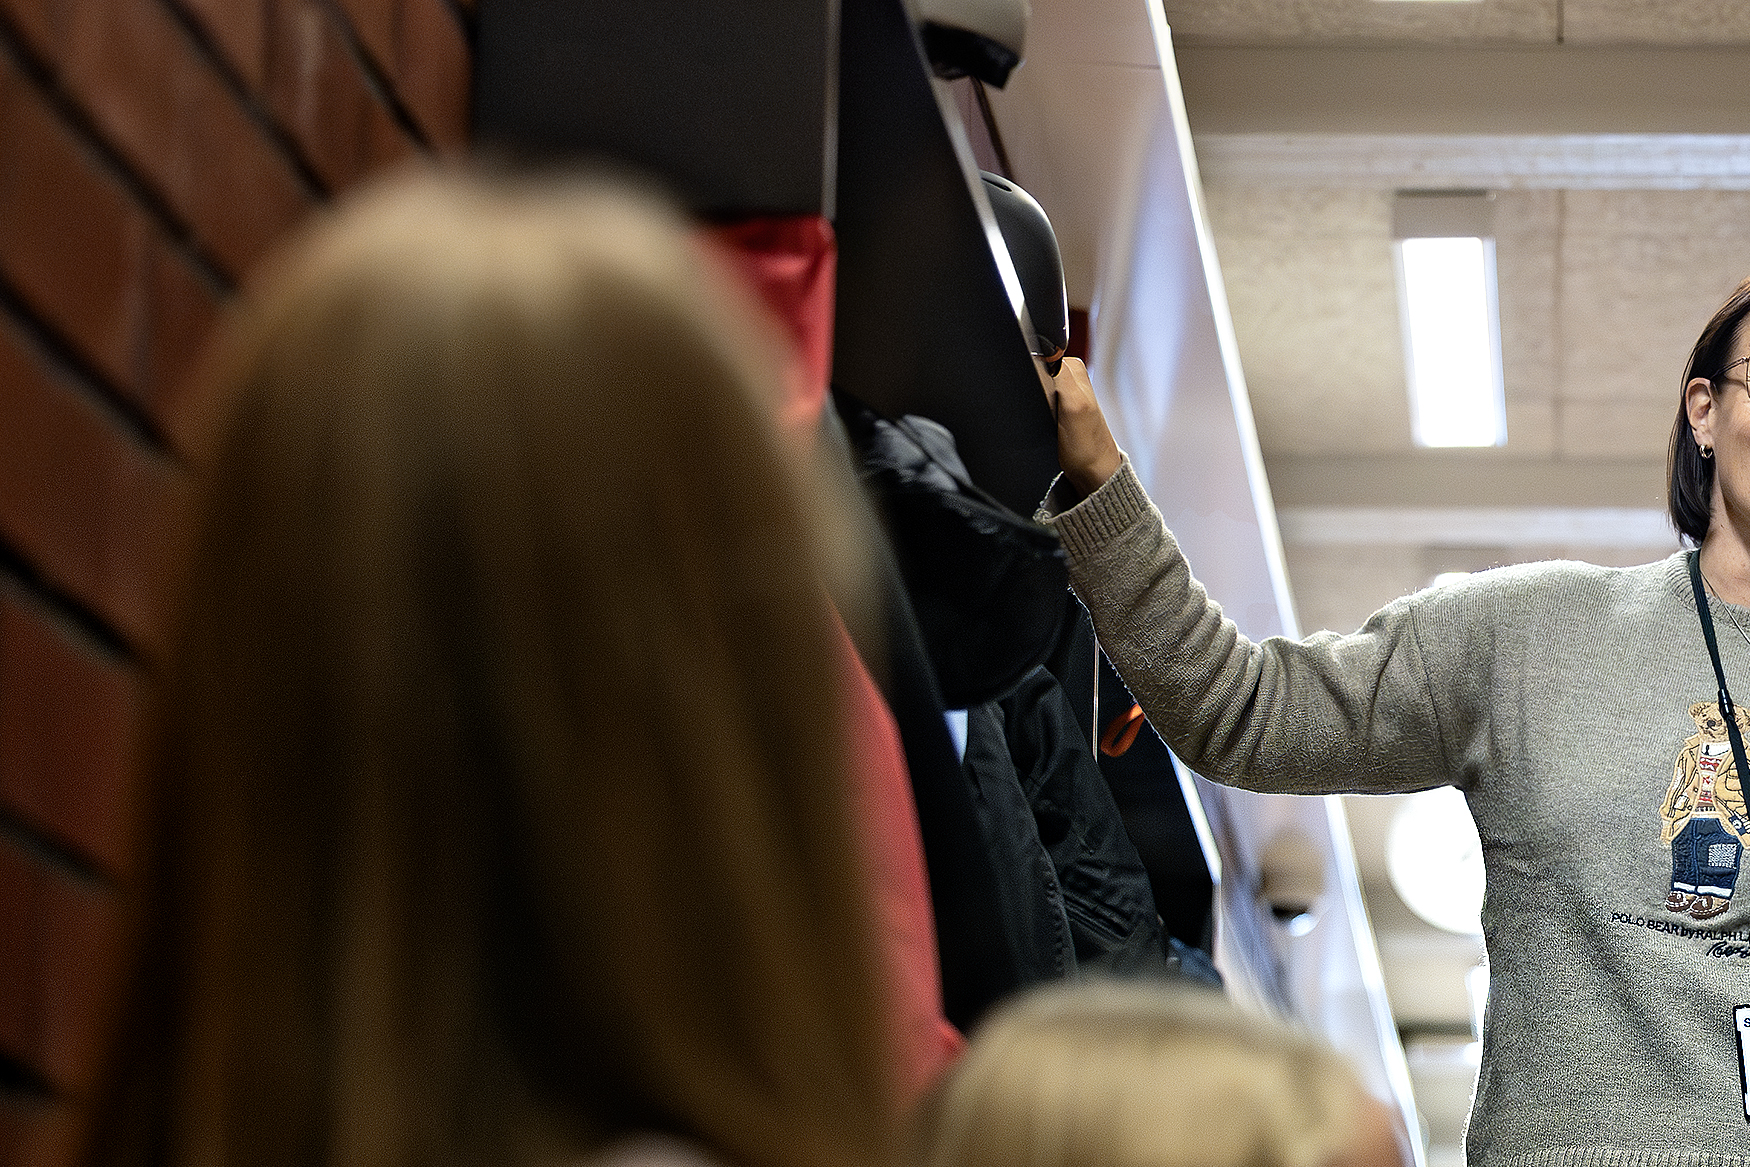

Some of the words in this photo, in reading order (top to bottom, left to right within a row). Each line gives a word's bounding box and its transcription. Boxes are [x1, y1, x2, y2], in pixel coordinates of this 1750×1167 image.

[1611, 912, 1645, 927] POLO
[1647, 919, 1680, 936] BEAR
[1695, 929, 1736, 941] RALPH
